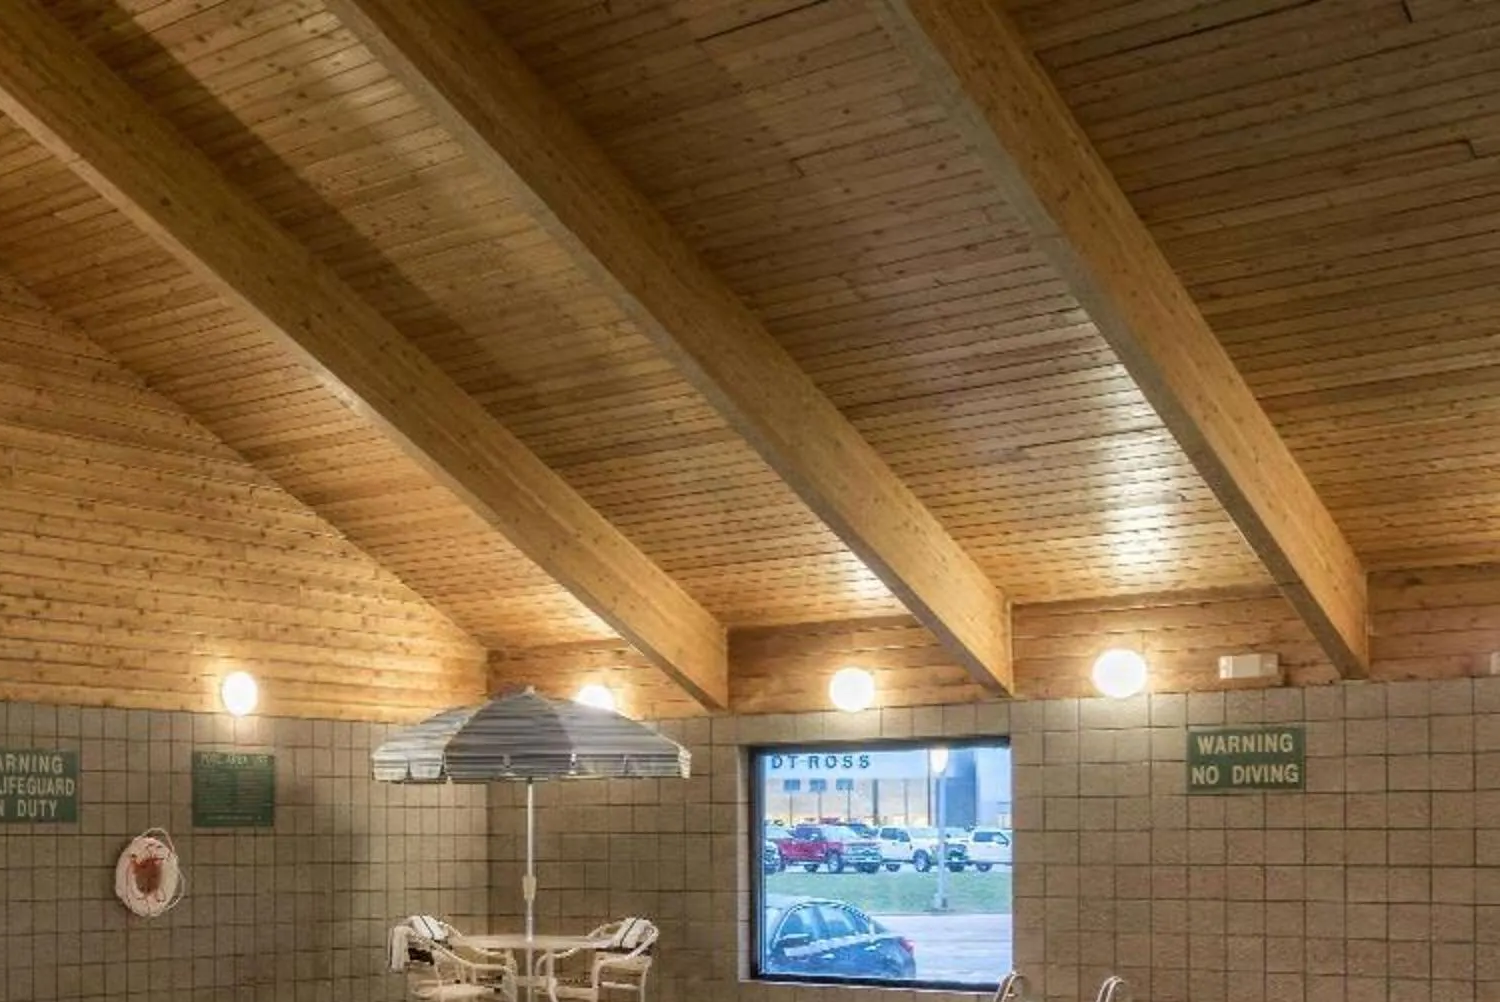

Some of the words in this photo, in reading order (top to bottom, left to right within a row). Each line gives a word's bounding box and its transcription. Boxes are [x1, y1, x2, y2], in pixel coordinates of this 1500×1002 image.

[1197, 733, 1294, 755] WARNING
[808, 755, 870, 769] ROSS
[1191, 766, 1220, 785] NO
[1232, 763, 1300, 784] DIVING
[17, 799, 58, 817] DUTY
